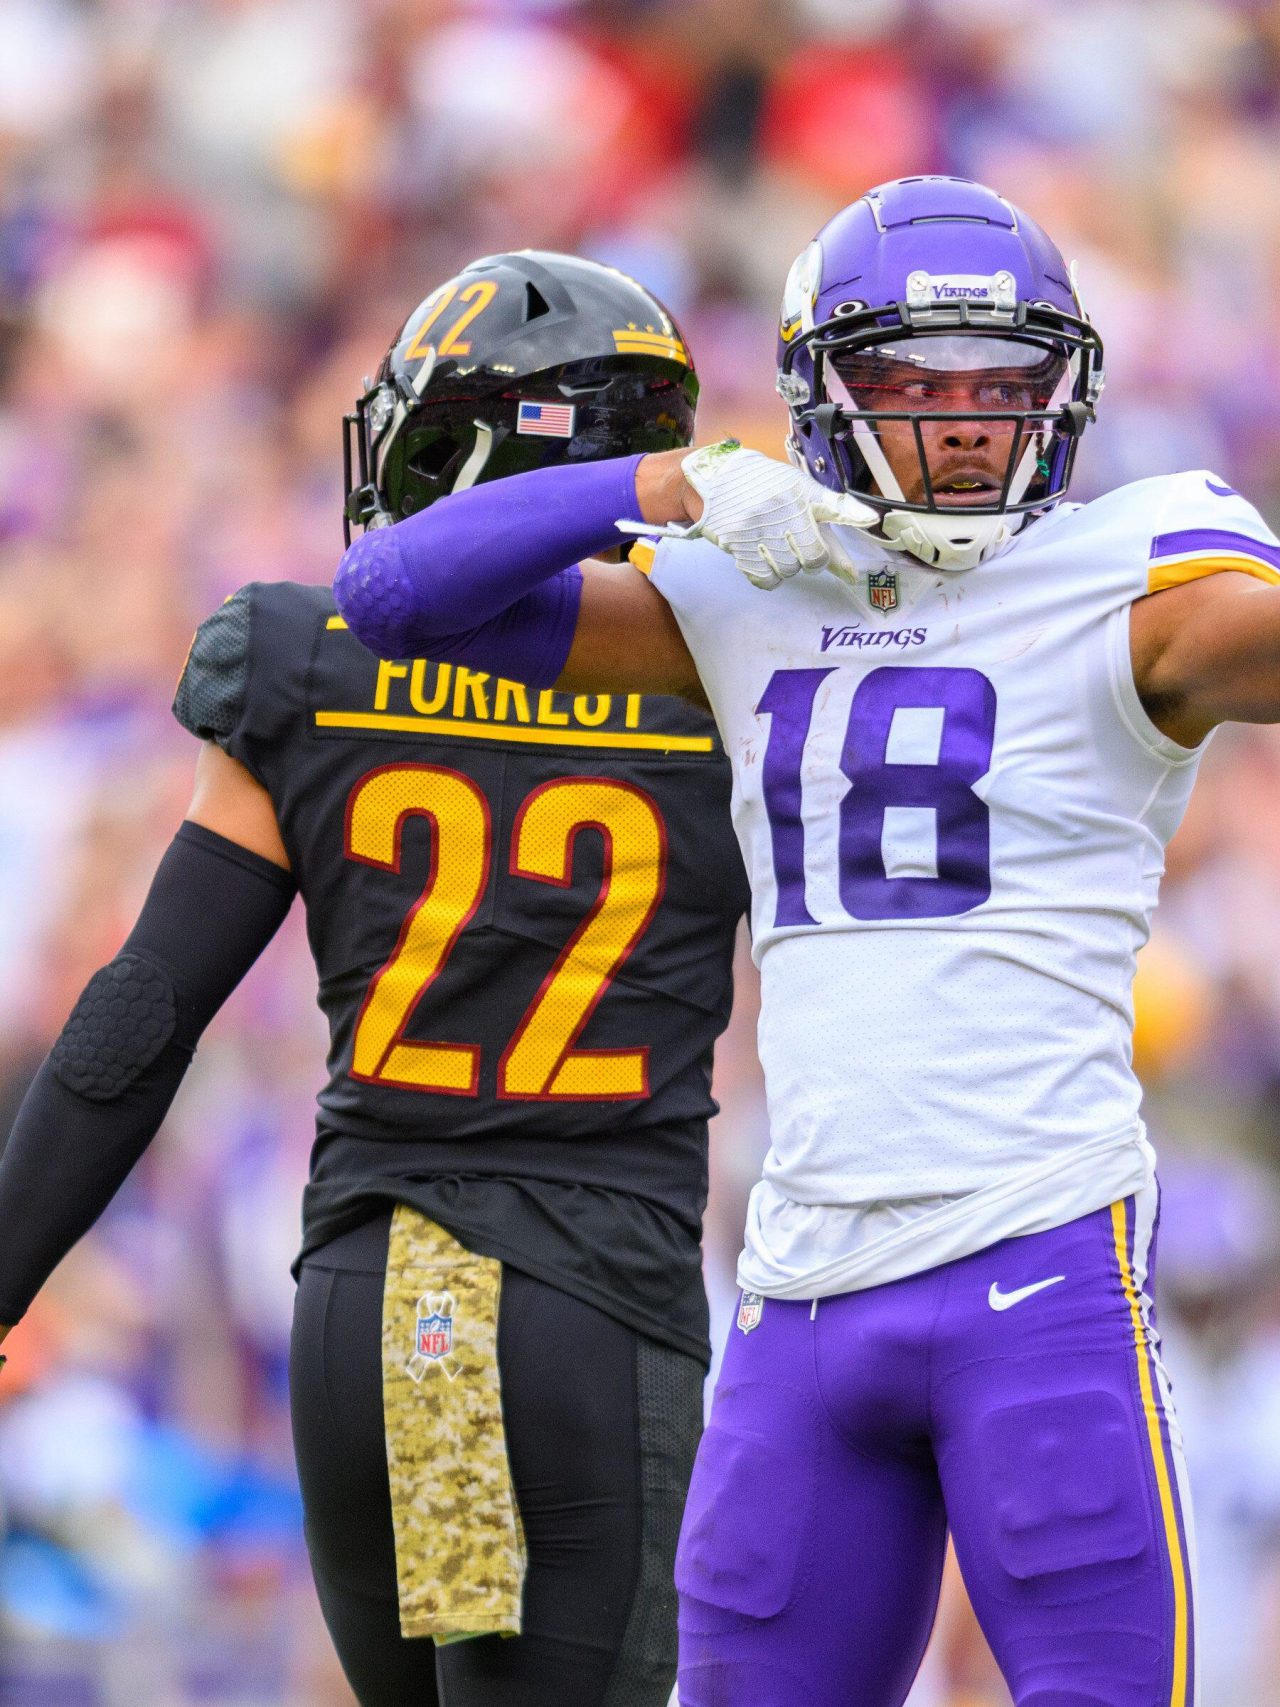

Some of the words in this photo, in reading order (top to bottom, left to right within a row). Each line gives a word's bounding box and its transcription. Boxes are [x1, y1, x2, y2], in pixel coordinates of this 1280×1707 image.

[404, 280, 499, 361] 22
[872, 588, 896, 608] NFL
[820, 622, 928, 652] VIKINGS
[755, 666, 997, 928] 18
[343, 762, 668, 1101] 22
[740, 1306, 757, 1325] NFL
[420, 1332, 450, 1354] NFL
